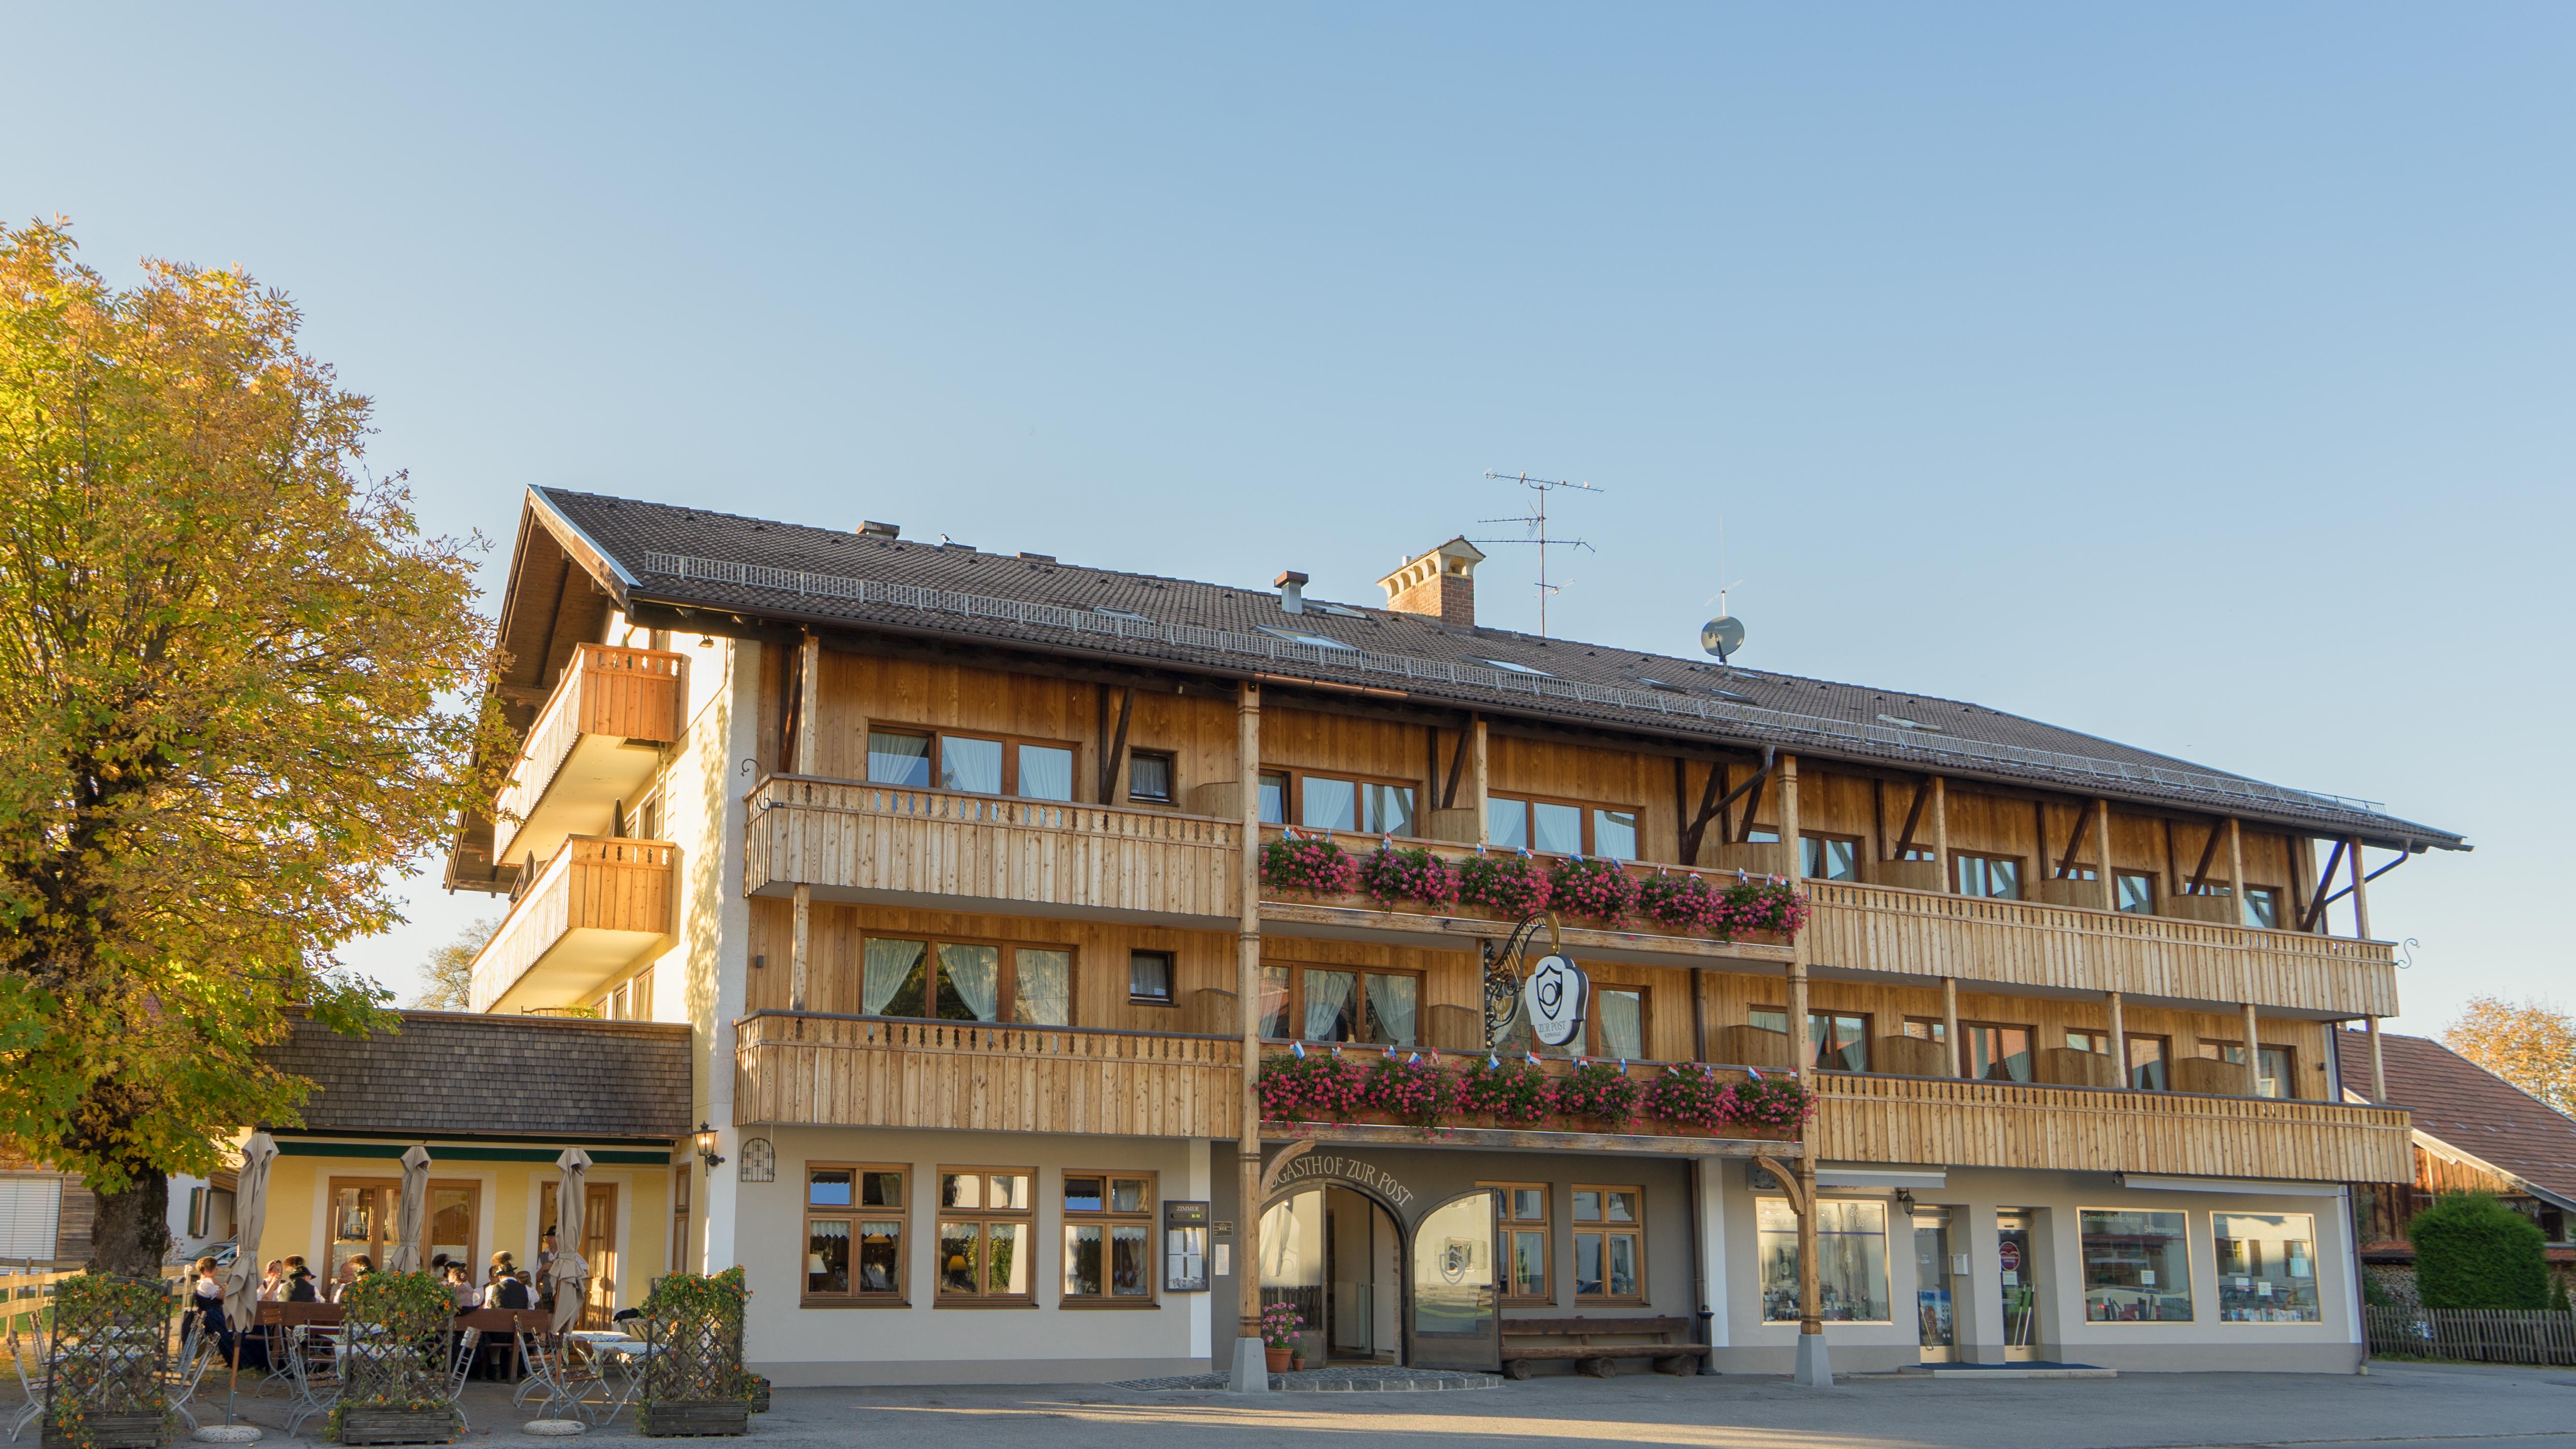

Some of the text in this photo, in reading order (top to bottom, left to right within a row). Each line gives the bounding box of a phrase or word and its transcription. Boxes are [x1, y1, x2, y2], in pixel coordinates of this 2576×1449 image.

[1539, 1020, 1566, 1033] ZUR POST
[1347, 1159, 1376, 1185] ZUR
[1377, 1172, 1413, 1207] POST
